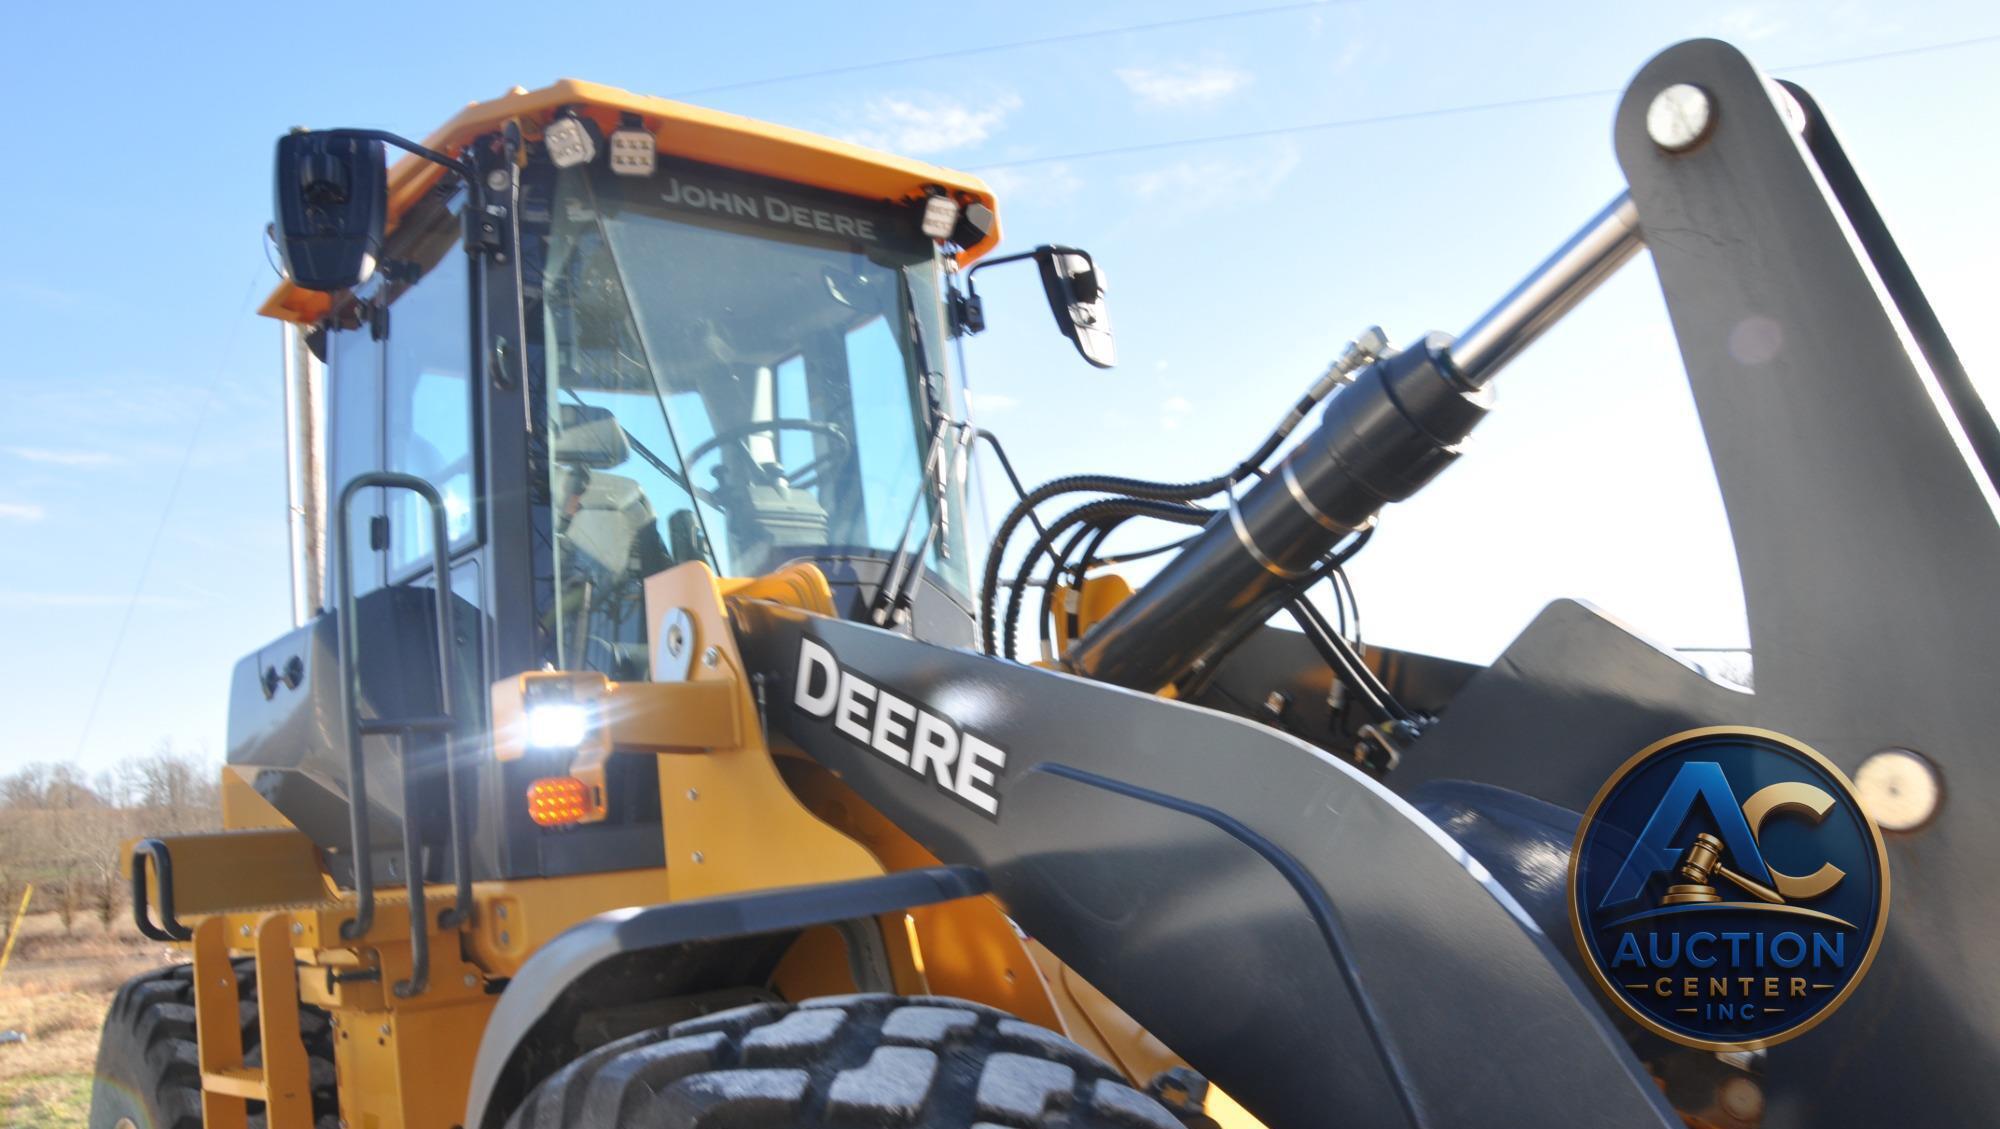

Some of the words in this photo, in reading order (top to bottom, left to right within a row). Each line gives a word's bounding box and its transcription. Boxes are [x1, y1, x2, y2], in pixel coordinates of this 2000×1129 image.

[661, 177, 759, 219] JOHN
[764, 196, 878, 241] DEERE
[795, 637, 1007, 816] DEERE
